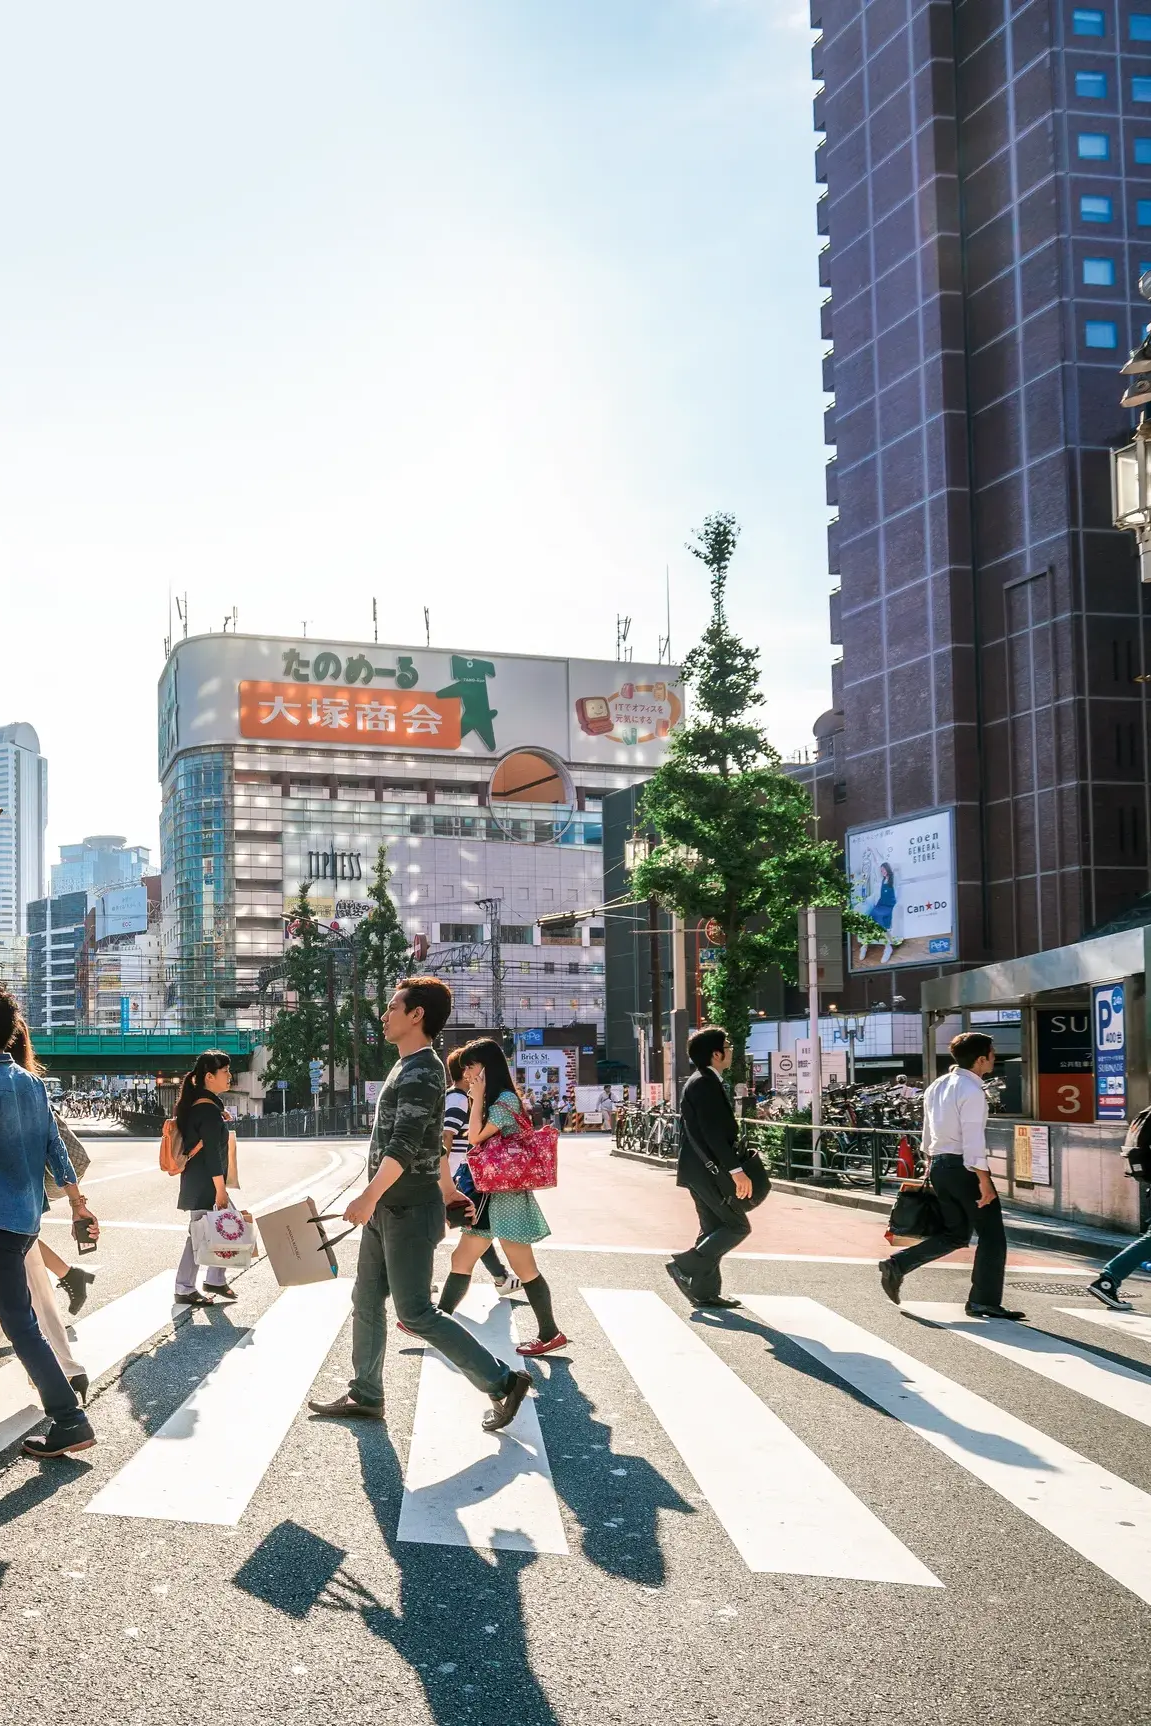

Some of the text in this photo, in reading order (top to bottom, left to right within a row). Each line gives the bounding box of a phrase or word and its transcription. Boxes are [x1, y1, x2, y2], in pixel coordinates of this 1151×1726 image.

[282, 648, 419, 689] たのめーる
[258, 696, 443, 734] 大塚商会
[614, 703, 664, 715] ITでオフィスを
[615, 715, 653, 724] 元気にする
[909, 832, 939, 845] coen
[908, 842, 941, 856] GENERAL
[913, 852, 936, 863] STORE
[1099, 1000, 1112, 1046] P
[1057, 1085, 1080, 1114] 3
